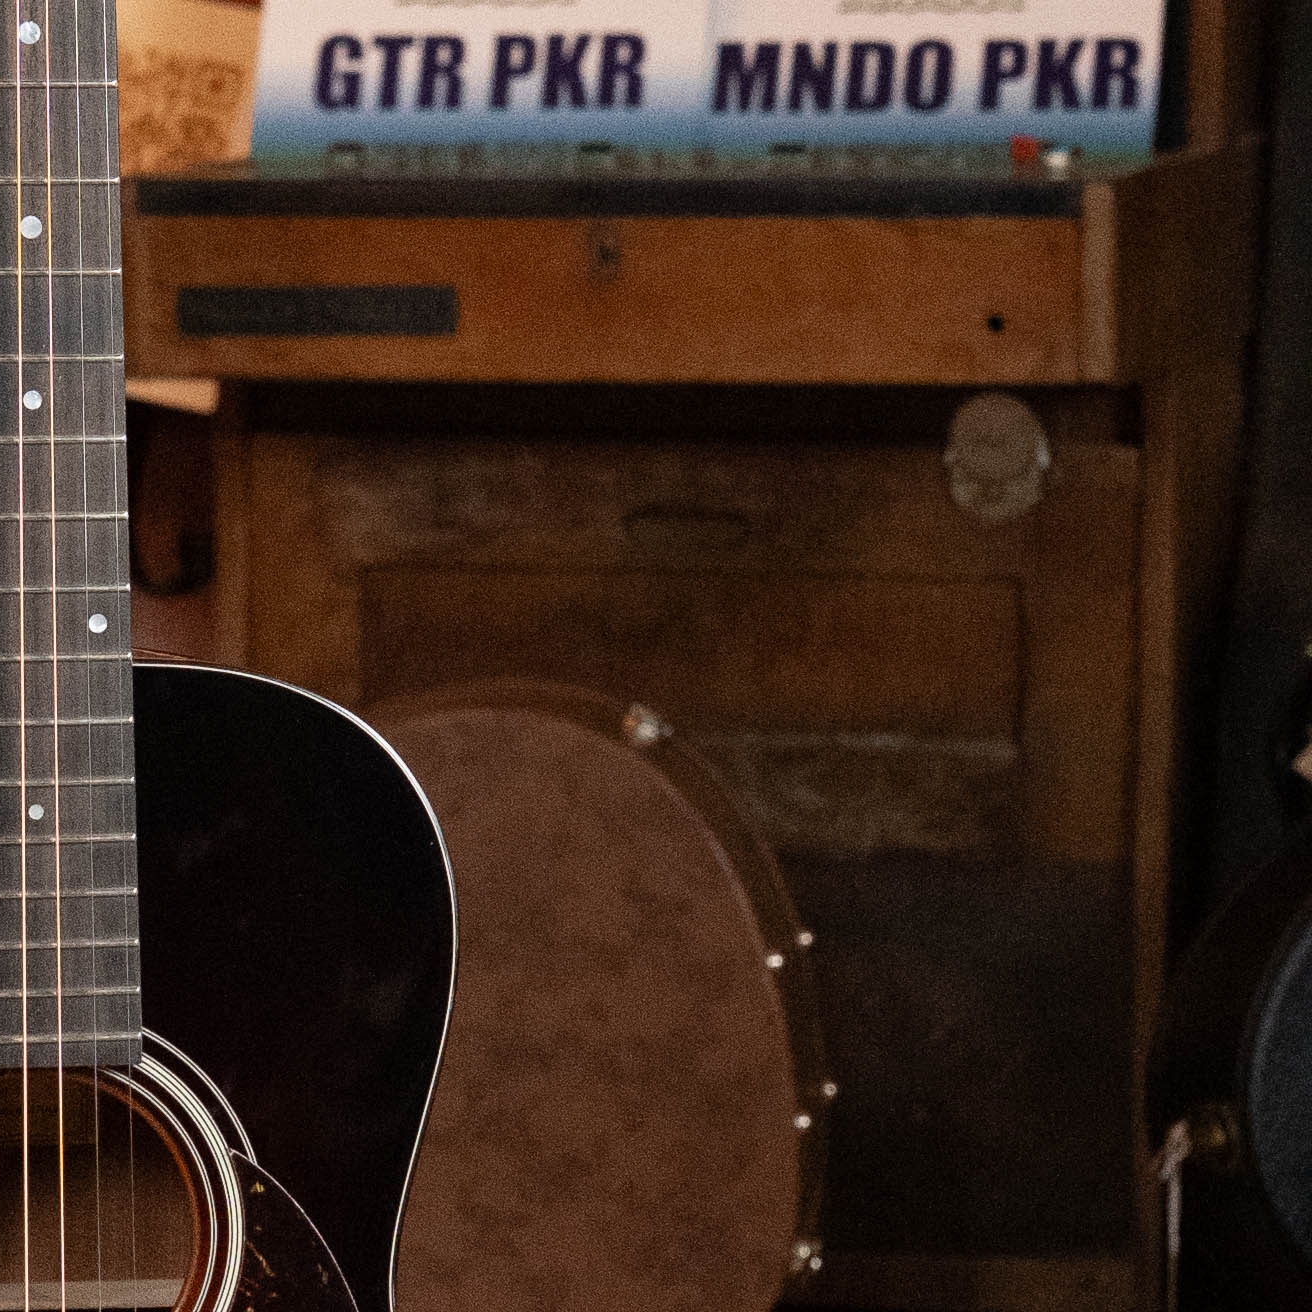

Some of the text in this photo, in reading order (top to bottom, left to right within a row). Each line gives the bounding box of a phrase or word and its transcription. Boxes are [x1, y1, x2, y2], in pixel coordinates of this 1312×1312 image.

[314, 32, 646, 110] GTR PKR
[711, 34, 1143, 112] MNDO PKR
